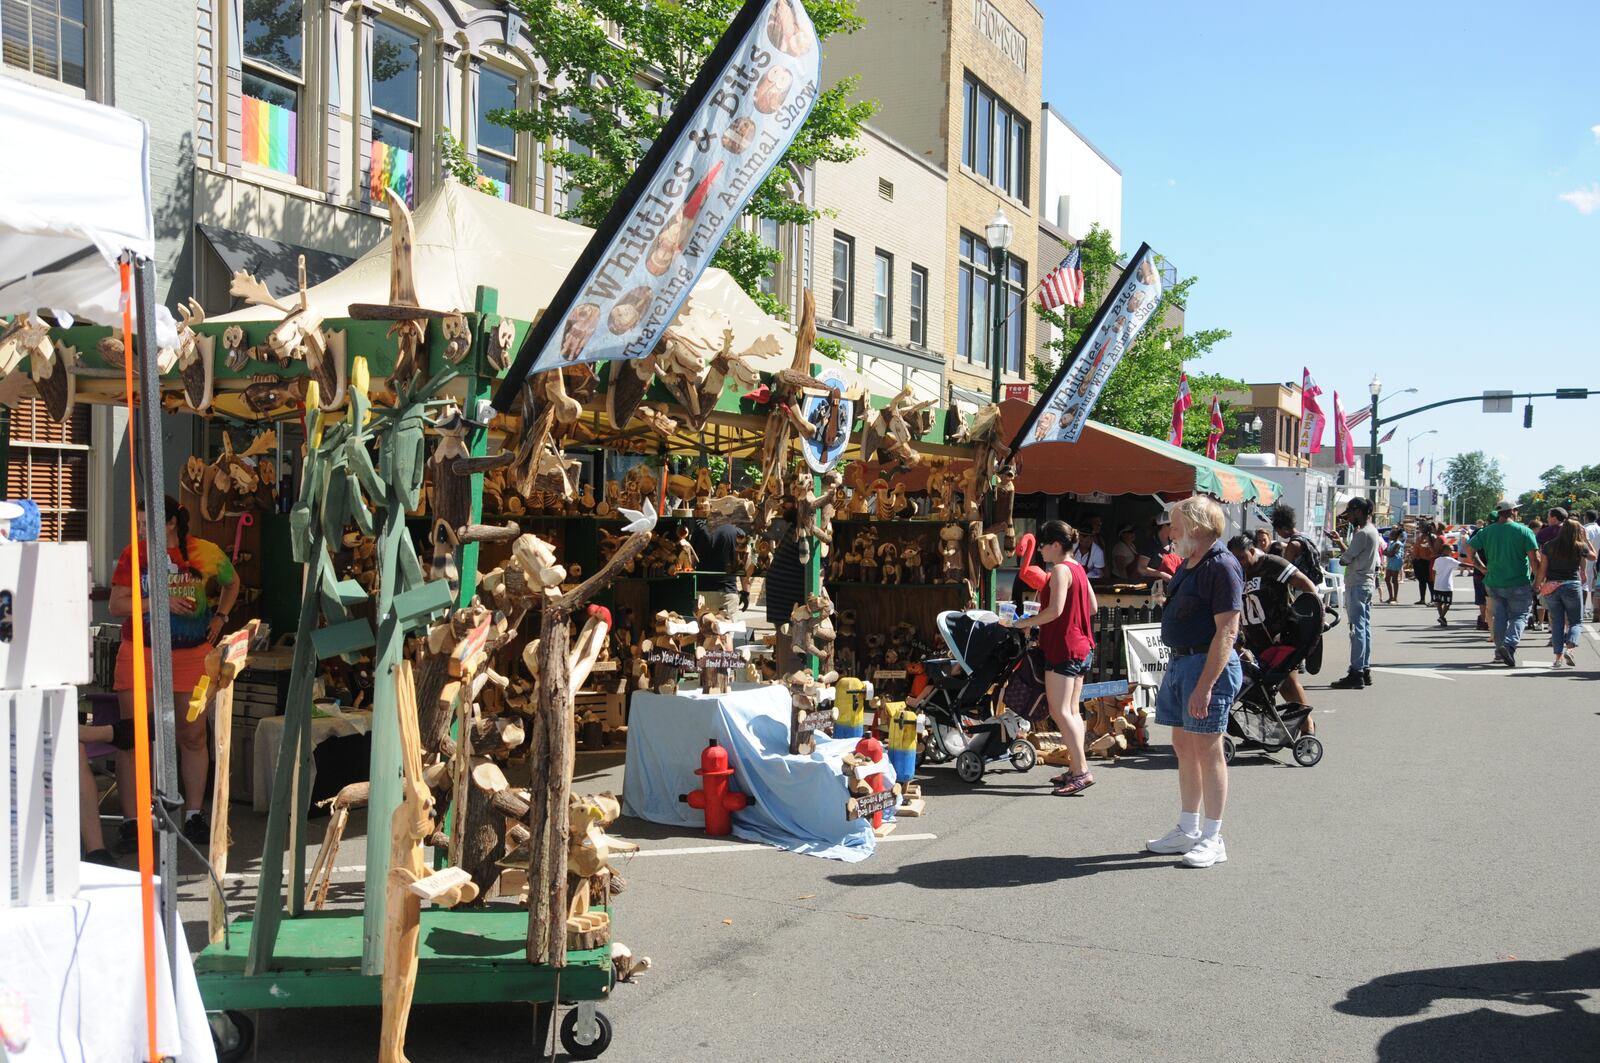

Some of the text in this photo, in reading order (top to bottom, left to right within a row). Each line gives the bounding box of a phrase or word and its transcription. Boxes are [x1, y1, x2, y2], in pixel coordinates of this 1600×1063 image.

[585, 44, 771, 302] Whittles & Bits
[622, 79, 819, 360] Traveling Wild Animal Show
[1050, 341, 1102, 413] Whittles
[1111, 281, 1137, 317] Bits
[1064, 390, 1096, 441] Traveling
[1091, 362, 1111, 387] Wild
[1109, 322, 1138, 363] Animal
[1300, 413, 1314, 448] REAM
[178, 586, 195, 597] FAIR
[1145, 635, 1164, 648] BAH
